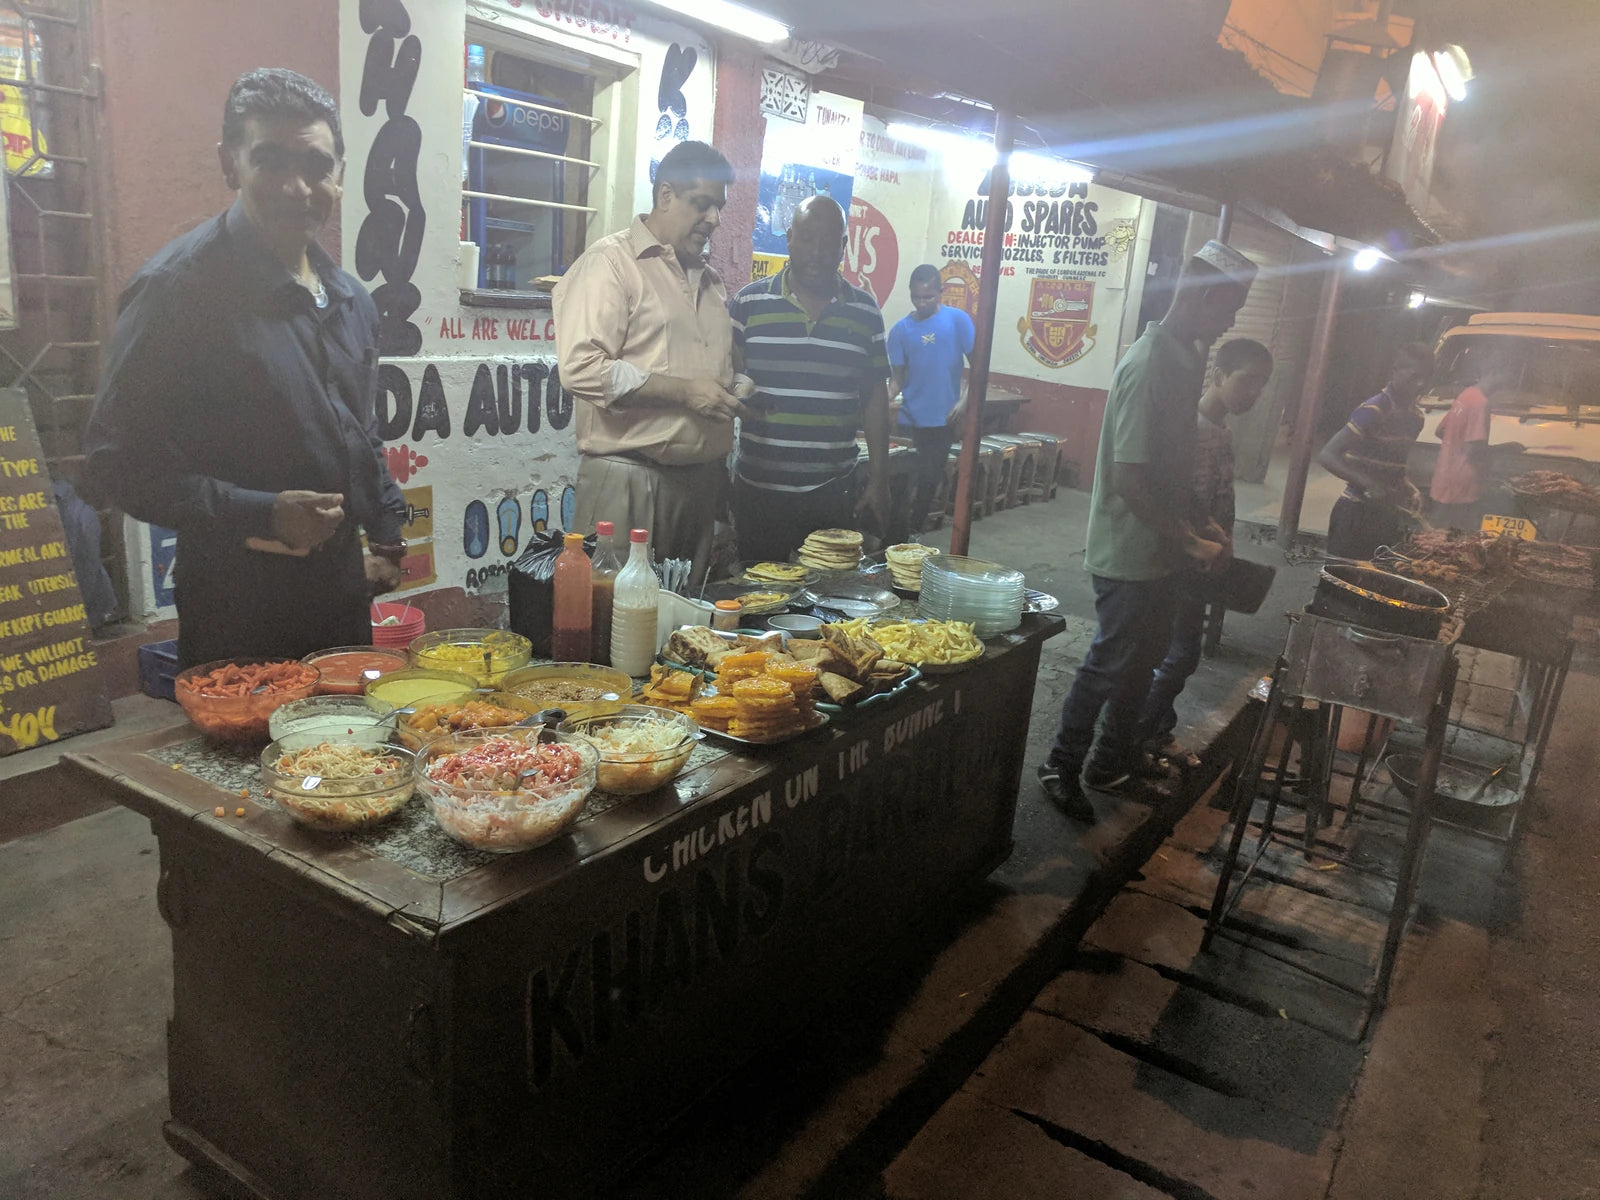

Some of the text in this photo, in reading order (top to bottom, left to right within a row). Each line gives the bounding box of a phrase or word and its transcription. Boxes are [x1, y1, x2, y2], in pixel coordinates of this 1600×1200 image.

[512, 106, 564, 133] pepsi
[1021, 200, 1099, 236] SPARES
[947, 231, 984, 246] DEALE
[1018, 234, 1070, 250] INJECTOR
[1072, 236, 1107, 250] PUMP
[941, 245, 984, 260] SERVIC
[1062, 251, 1109, 267] FILTERS
[751, 260, 769, 275] FIAT
[971, 264, 982, 275] RE
[471, 318, 499, 341] ARE
[463, 362, 574, 438] AUTO
[1, 458, 39, 478] TYPE
[18, 491, 48, 511] ARE
[1, 512, 30, 530] THE
[16, 670, 39, 688] OR
[38, 651, 98, 683] DAMAGE
